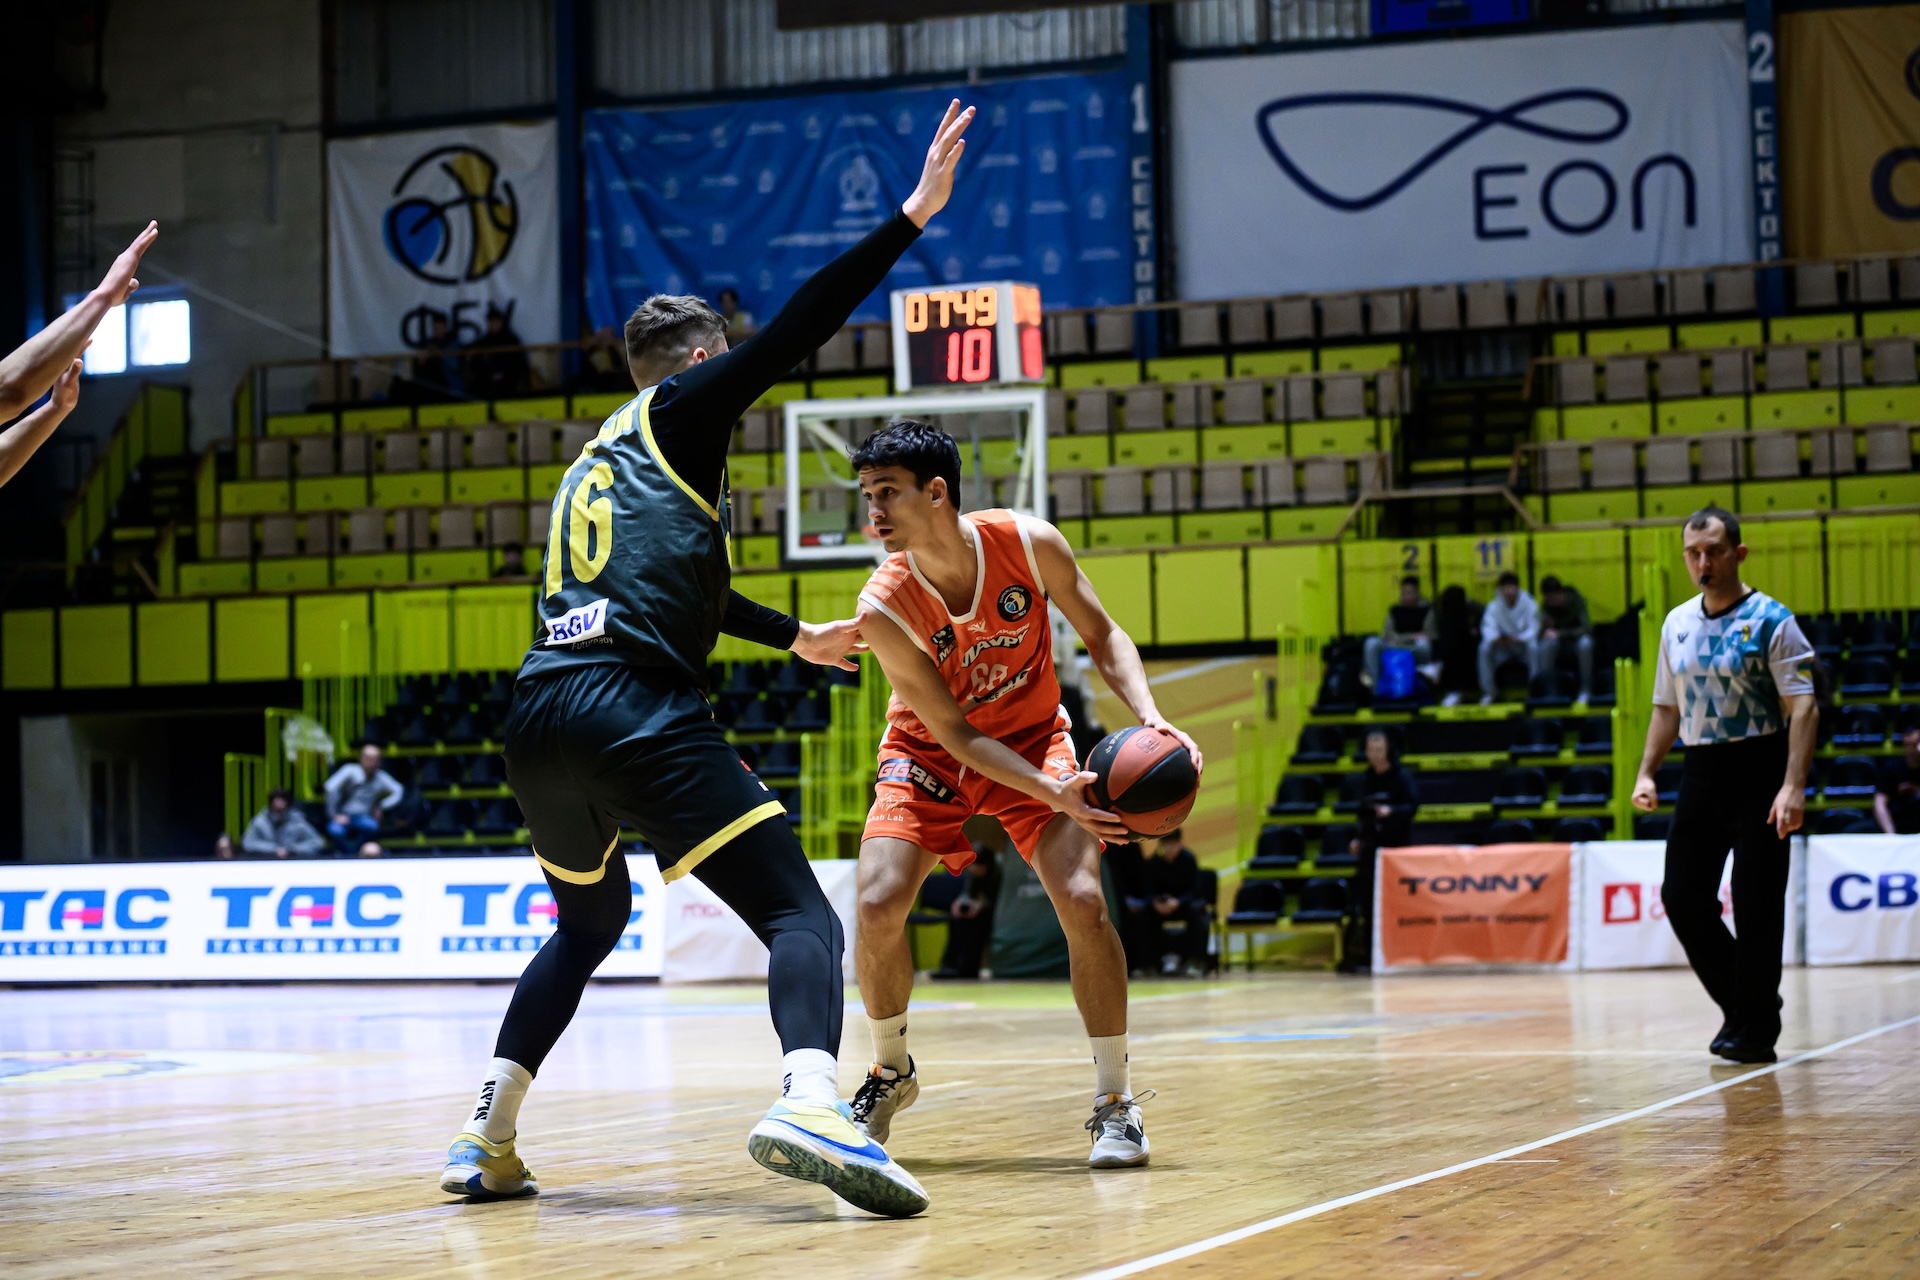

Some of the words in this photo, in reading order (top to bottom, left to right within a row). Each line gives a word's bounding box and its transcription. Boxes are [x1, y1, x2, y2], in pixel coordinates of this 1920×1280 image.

[1748, 33, 1775, 82] 2
[1131, 83, 1150, 133] 1
[946, 328, 993, 382] 10
[1401, 545, 1419, 570] 2
[552, 607, 600, 641] BGV
[1399, 873, 1549, 896] TONNY
